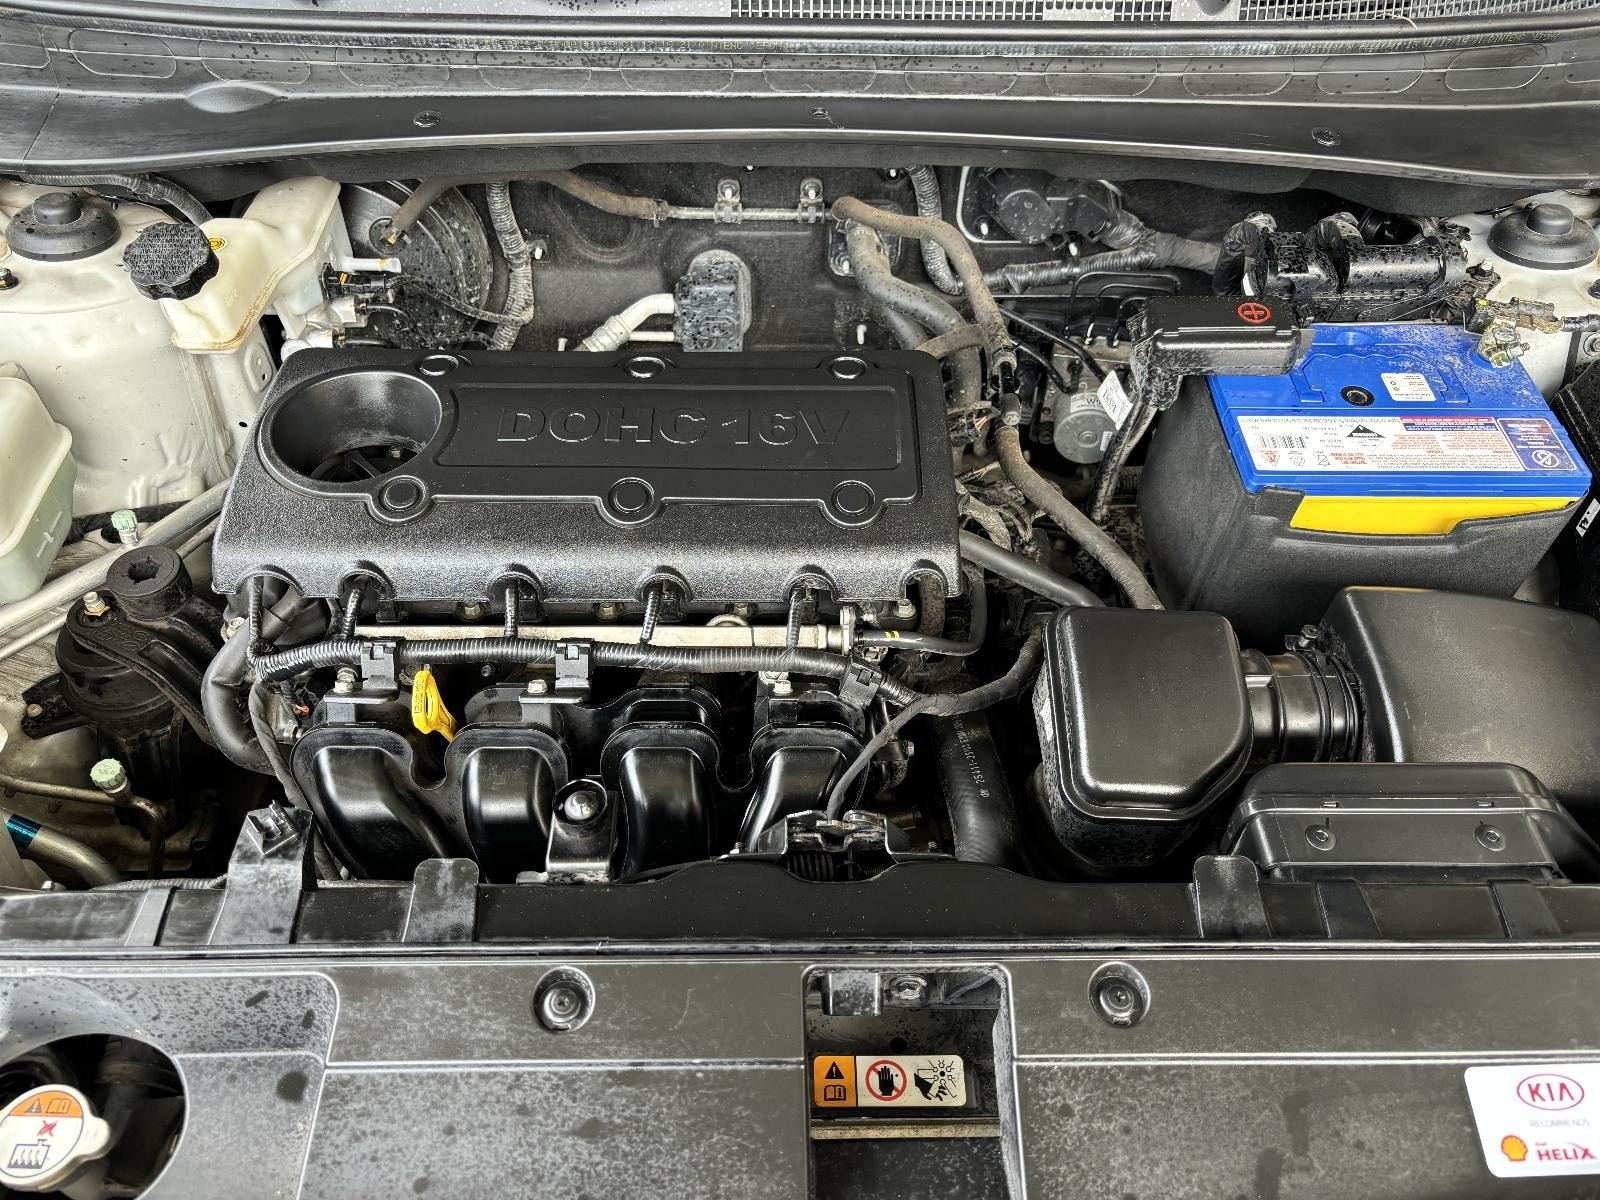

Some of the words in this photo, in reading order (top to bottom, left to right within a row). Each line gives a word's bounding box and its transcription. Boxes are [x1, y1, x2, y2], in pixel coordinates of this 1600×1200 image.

[497, 407, 707, 445] DOHC
[721, 407, 851, 445] 16V
[1527, 1083, 1575, 1102] KIA
[1537, 1148, 1597, 1161] HELIX
